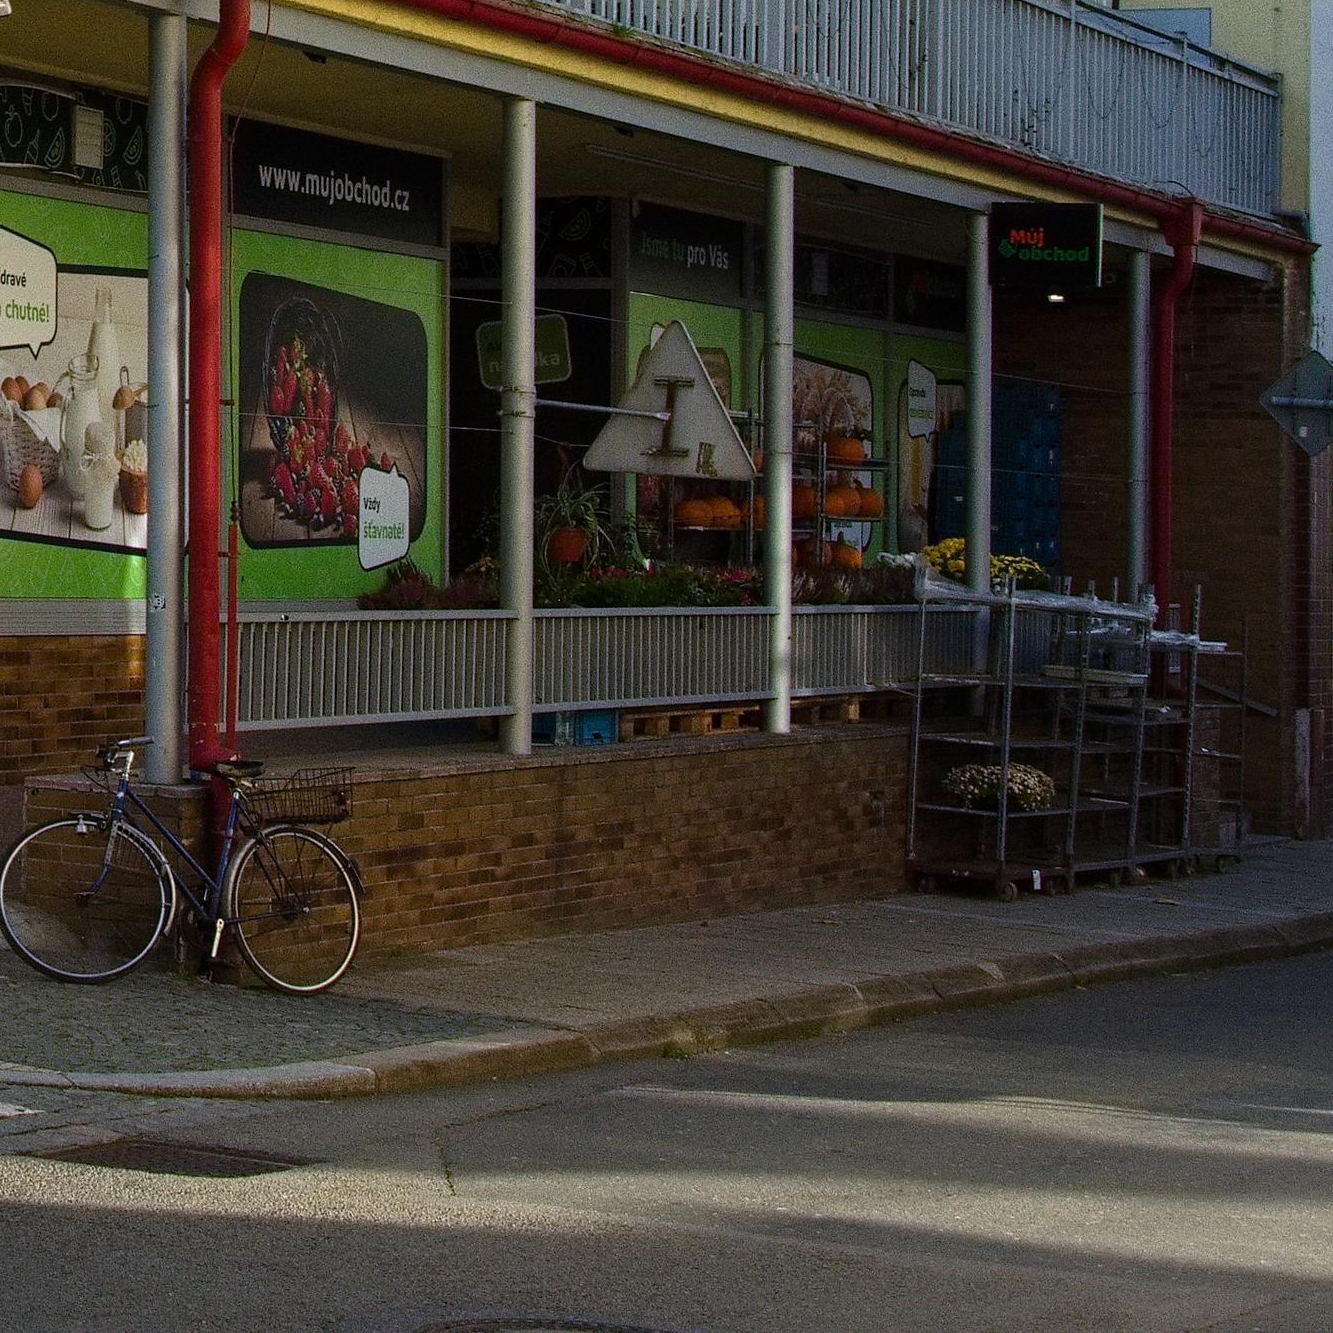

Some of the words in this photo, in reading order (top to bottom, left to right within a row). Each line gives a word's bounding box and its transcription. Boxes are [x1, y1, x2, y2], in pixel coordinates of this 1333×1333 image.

[258, 164, 410, 212] www.mujobchod.cz
[687, 244, 707, 268] pro
[709, 242, 730, 270] Vás
[1018, 245, 1091, 263] obchod
[5, 299, 50, 323] chutné!
